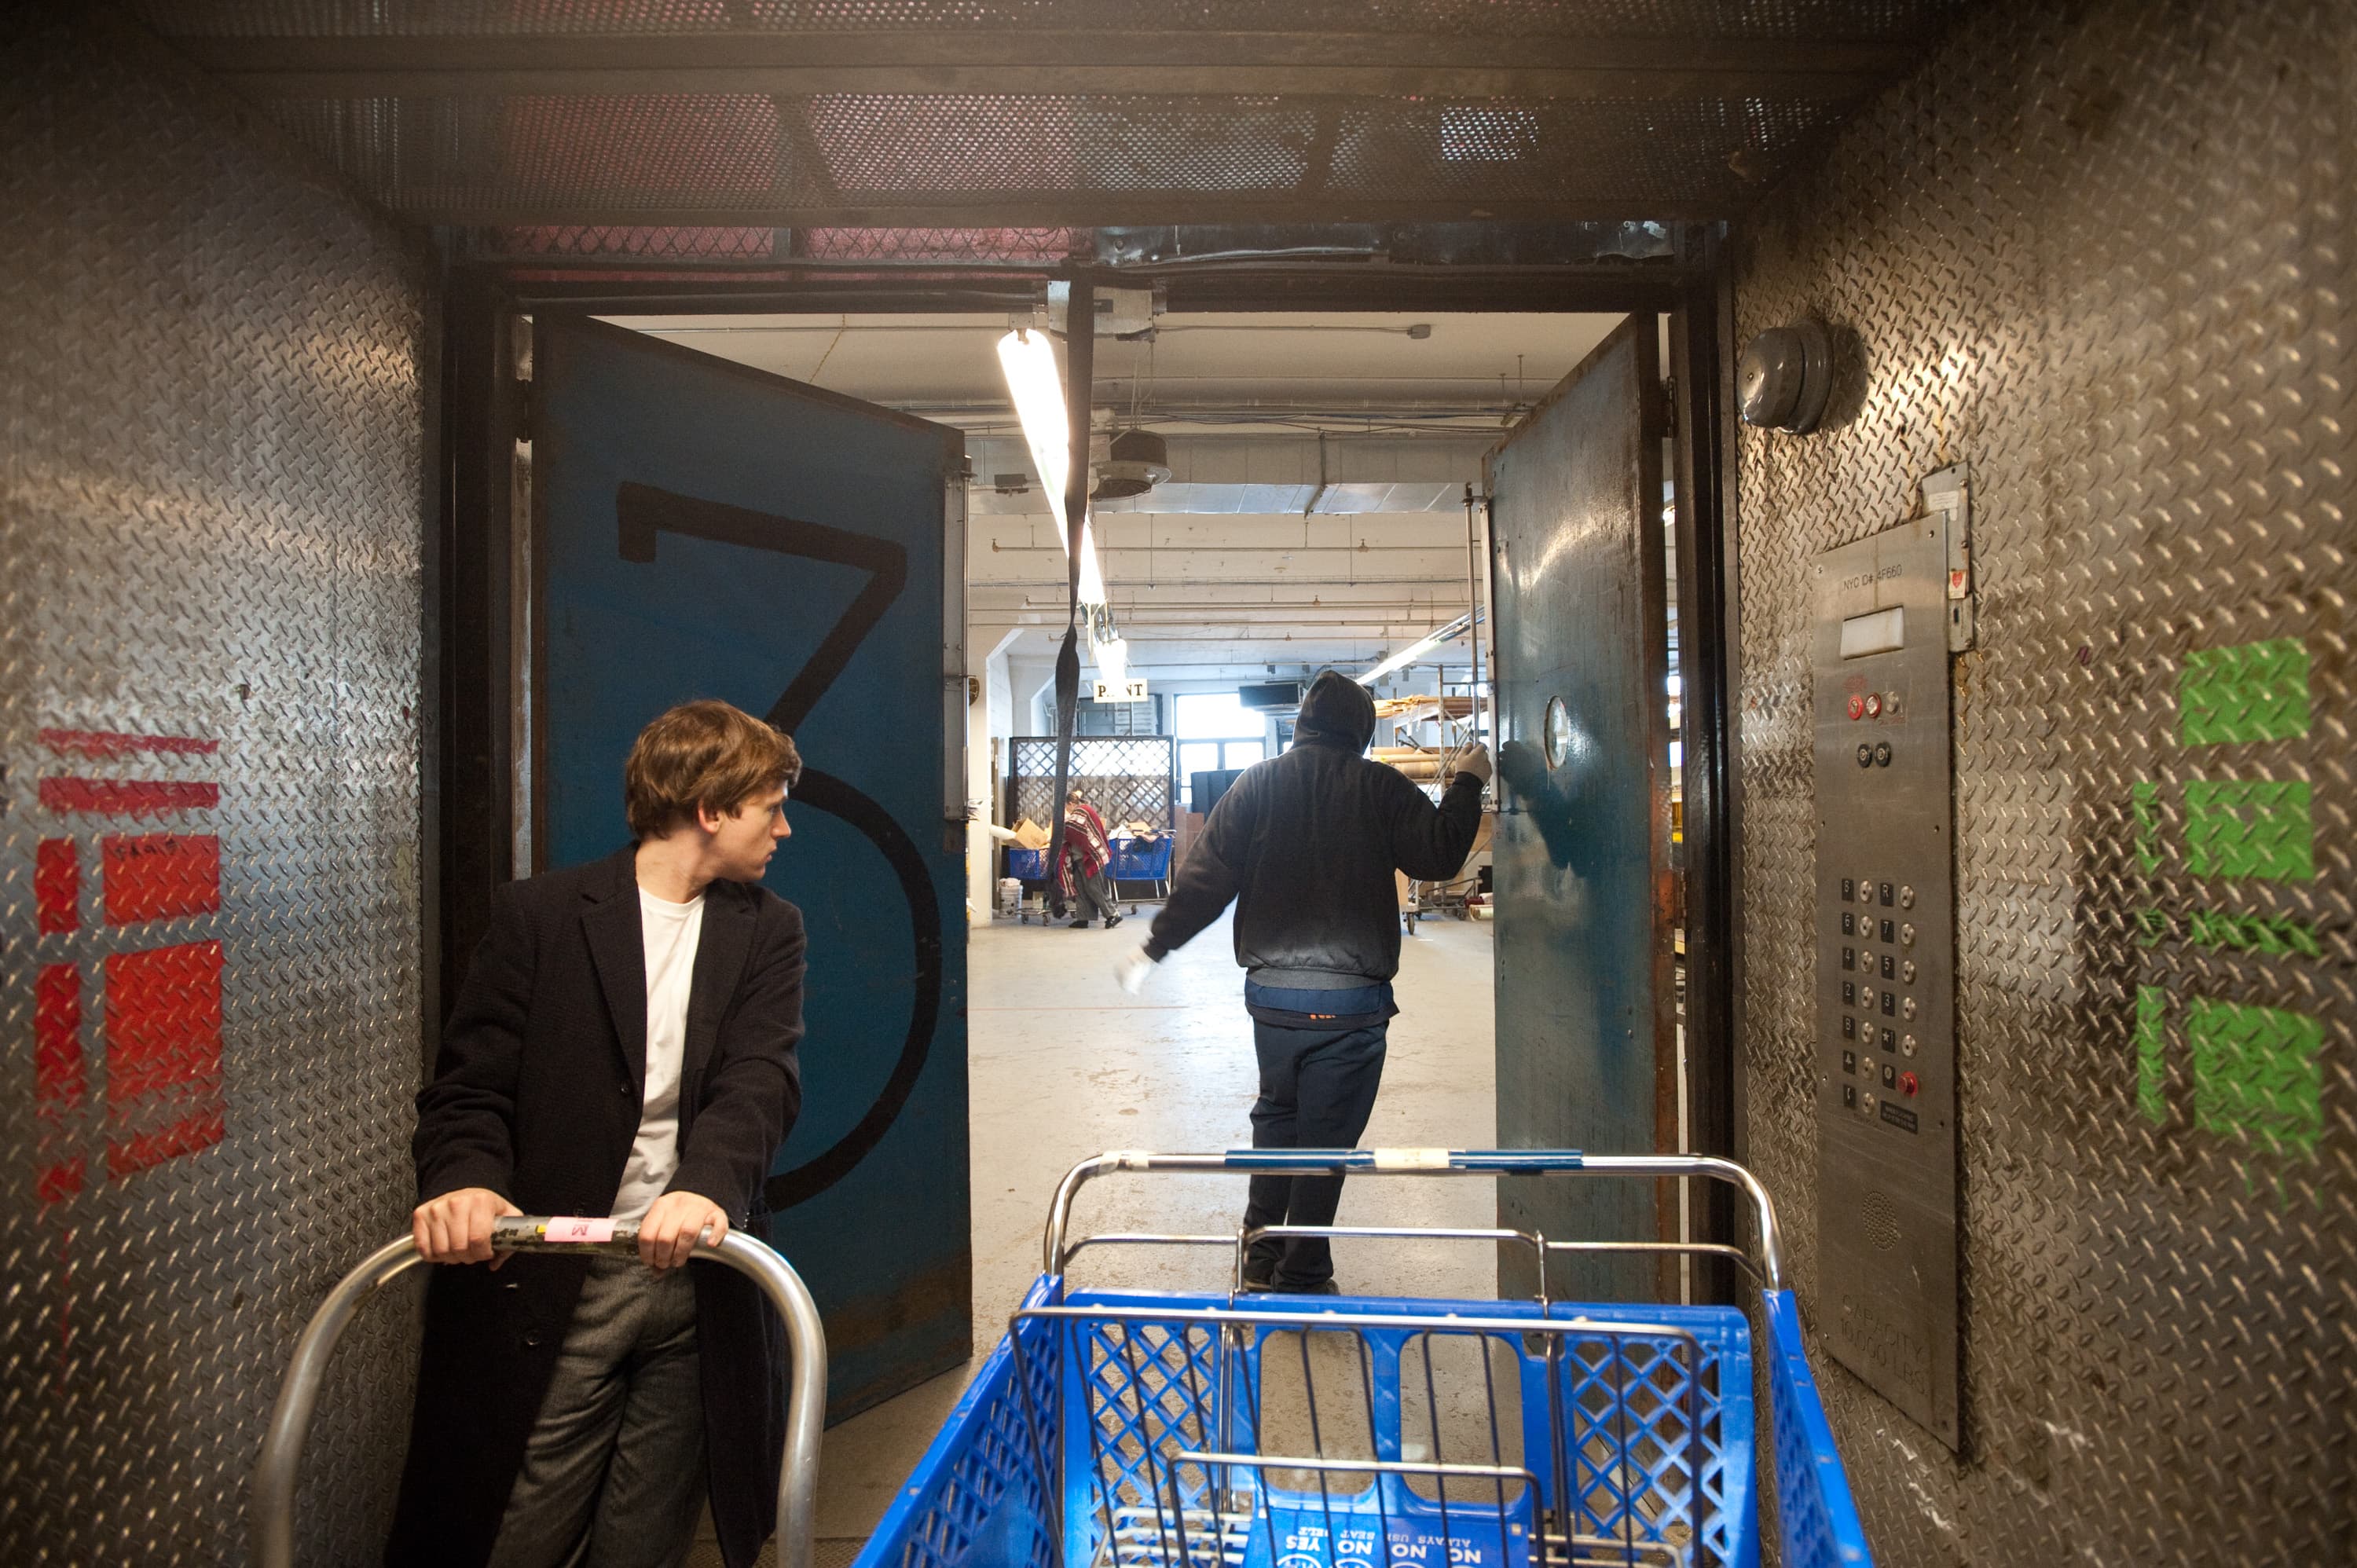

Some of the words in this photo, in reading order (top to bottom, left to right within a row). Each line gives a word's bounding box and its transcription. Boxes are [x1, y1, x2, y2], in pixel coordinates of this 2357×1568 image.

[1843, 577, 1860, 591] NYC
[1098, 683, 1143, 698] PNT
[617, 480, 942, 1212] 3
[1844, 880, 1849, 892] 8
[1882, 884, 1889, 898] R
[1845, 914, 1850, 927] 6
[1883, 921, 1890, 934] 7
[1846, 950, 1850, 961] 4
[1885, 958, 1890, 970] 5
[1846, 984, 1851, 996] 2
[1885, 995, 1890, 1006] 3
[1846, 1018, 1851, 1031] B
[1842, 1294, 1924, 1363] CAPACITY
[1298, 1526, 1328, 1537] ELT
[1340, 1530, 1376, 1541] SEAT
[1285, 1534, 1321, 1552] YES
[1337, 1540, 1373, 1555] NO
[1391, 1543, 1427, 1559] NO
